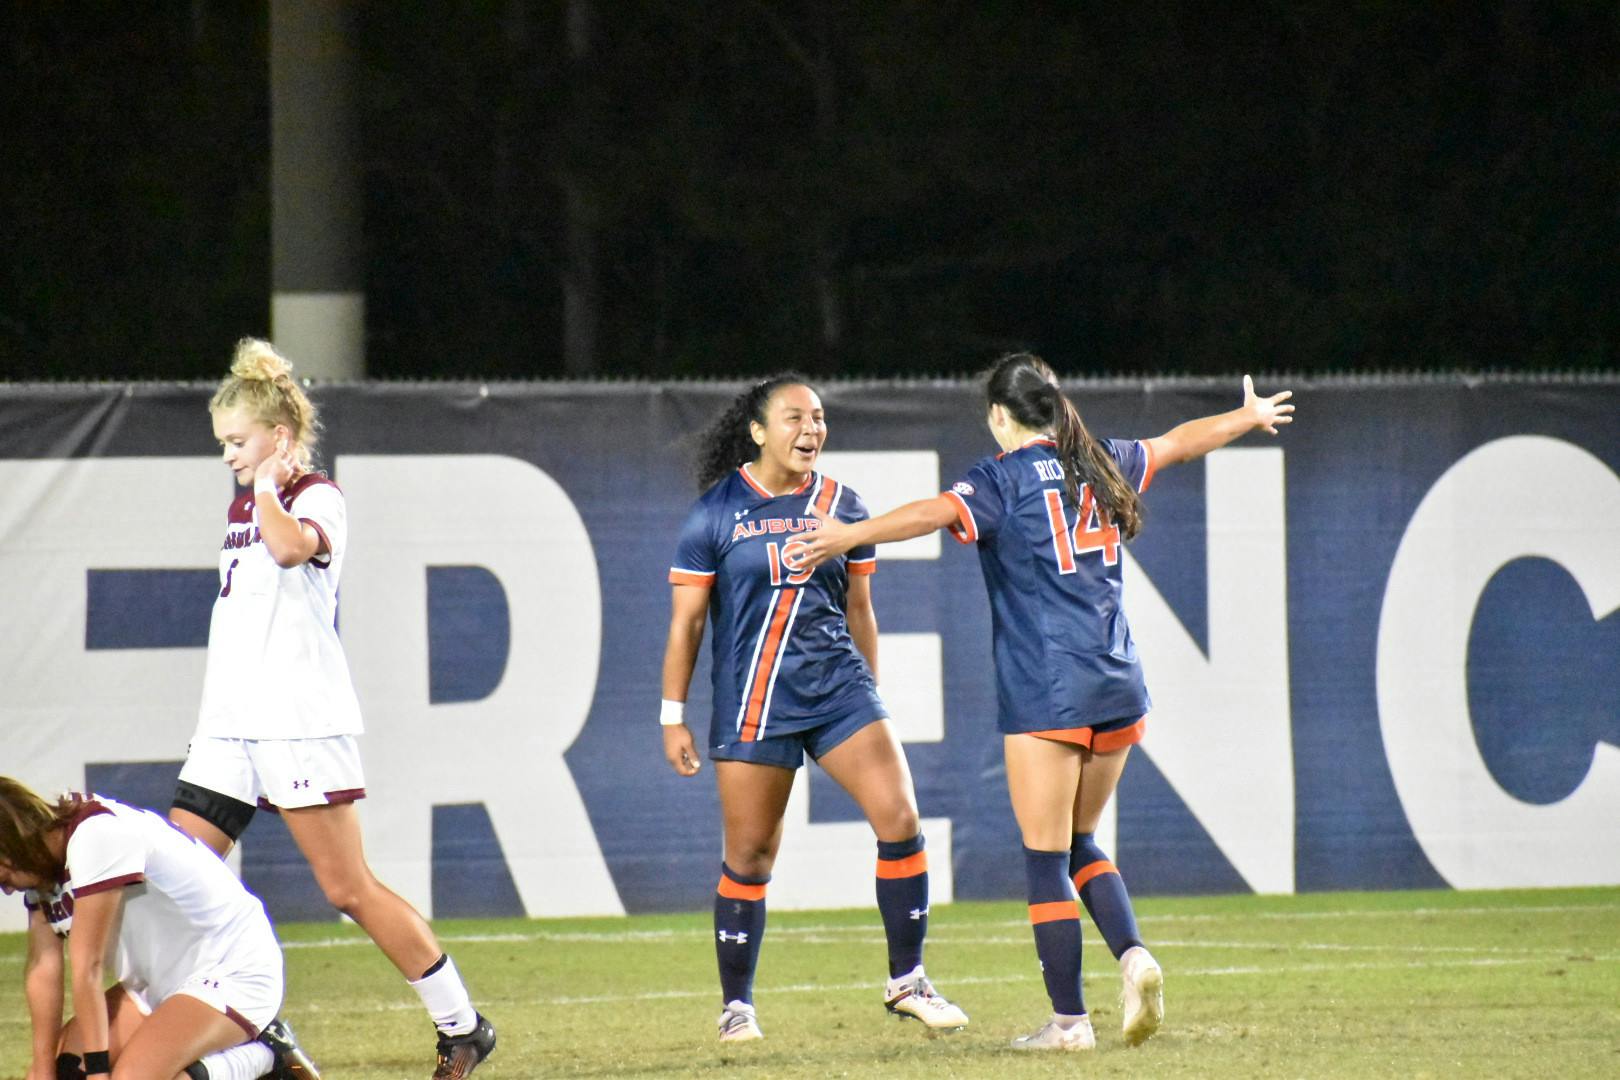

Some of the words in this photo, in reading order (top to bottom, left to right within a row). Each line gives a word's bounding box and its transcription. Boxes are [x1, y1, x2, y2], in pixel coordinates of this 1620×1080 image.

[732, 518, 821, 542] AUBUR
[1043, 482, 1121, 575] 14
[766, 541, 817, 586] 19
